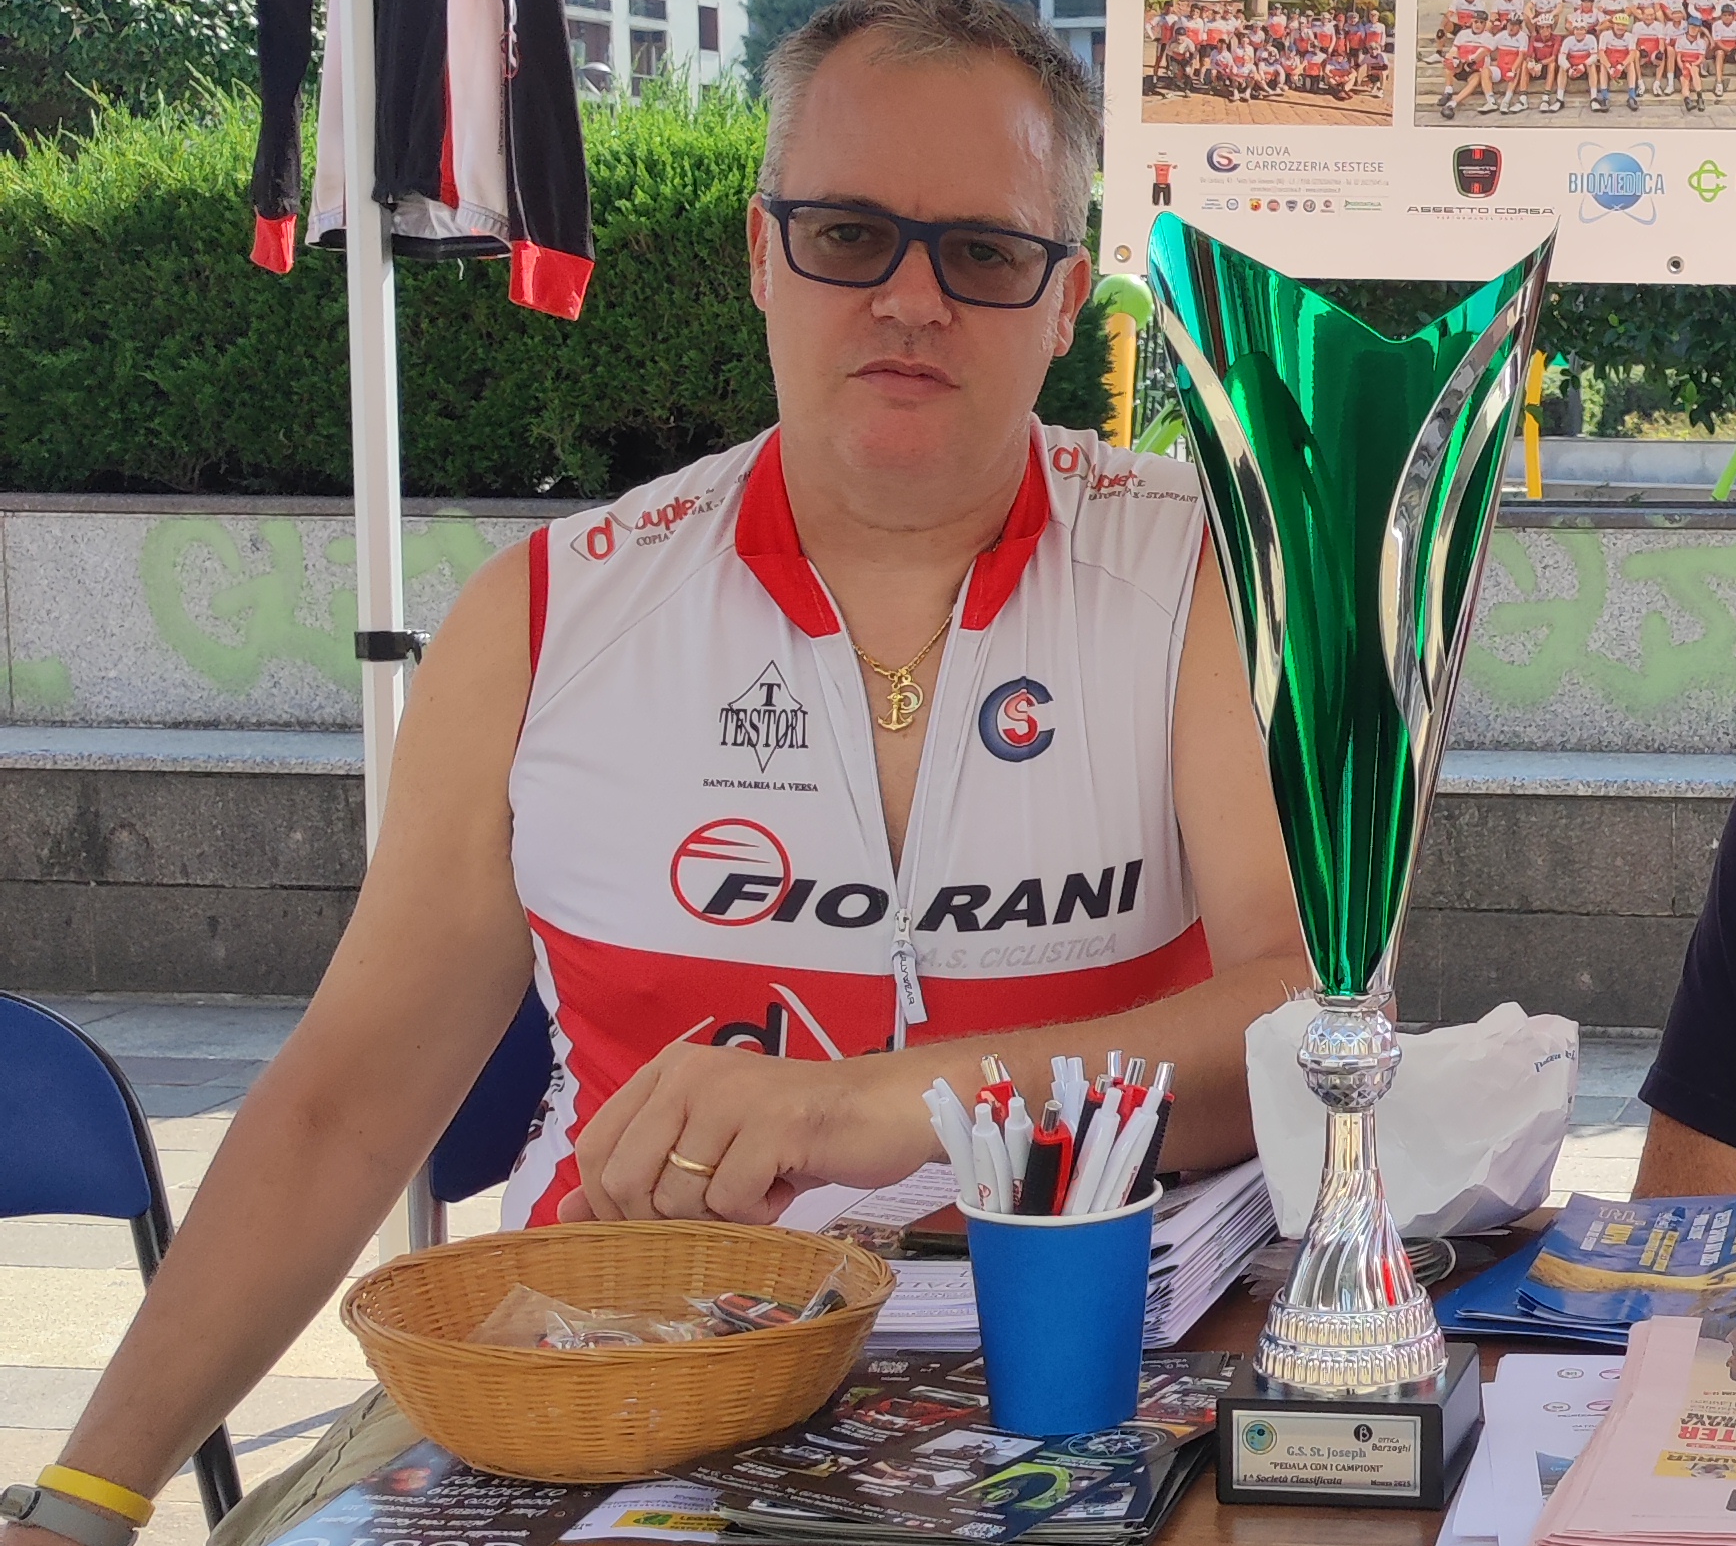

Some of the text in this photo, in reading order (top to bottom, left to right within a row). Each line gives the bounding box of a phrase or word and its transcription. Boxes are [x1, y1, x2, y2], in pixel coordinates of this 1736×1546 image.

[1246, 145, 1291, 157] NUOVA
[1245, 160, 1385, 173] CARROZZERIA SESTESE
[1568, 172, 1665, 195] BIOMEDICA
[1406, 206, 1554, 215] ASSETTO CORSA
[719, 707, 809, 750] TESTORI
[702, 778, 818, 793] SANTA MARIA LA VERSA
[979, 933, 1117, 970] CICLISTICA
[1286, 1445, 1367, 1461] G.S. St. Joseph
[1309, 1462, 1329, 1472] CON
[1255, 1473, 1343, 1486] Società Classificata
